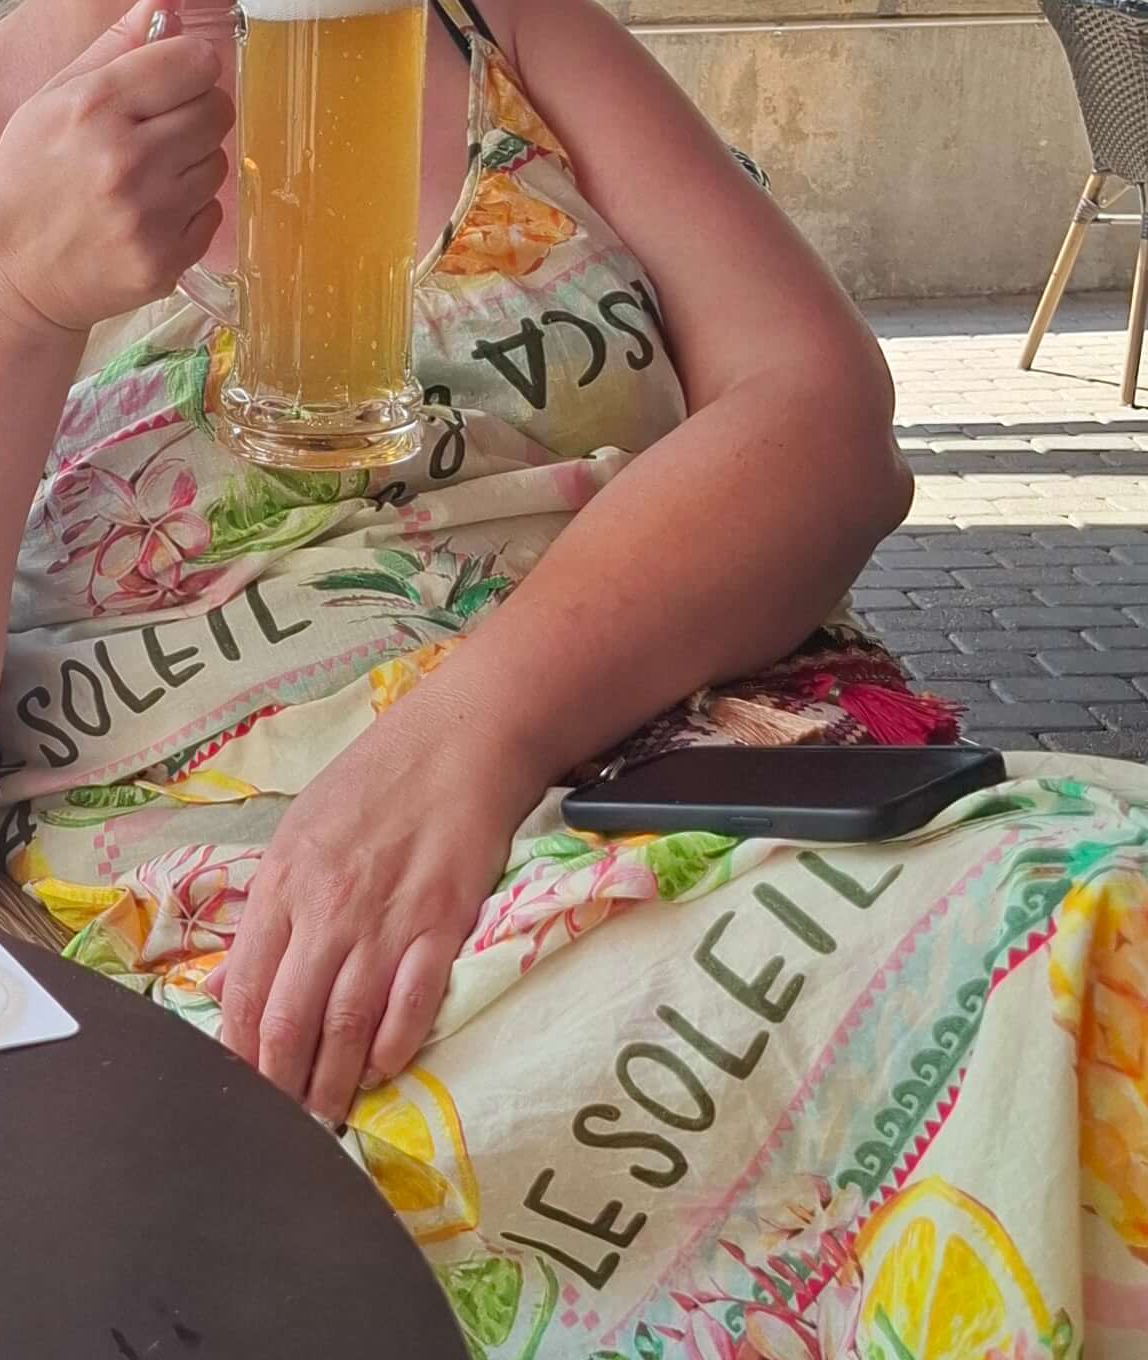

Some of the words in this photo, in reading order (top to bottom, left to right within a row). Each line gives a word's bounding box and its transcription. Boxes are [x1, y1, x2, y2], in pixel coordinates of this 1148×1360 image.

[16, 580, 312, 769] SOLEIL
[572, 850, 905, 1189] SOLEIL
[500, 1167, 648, 1291] LE
